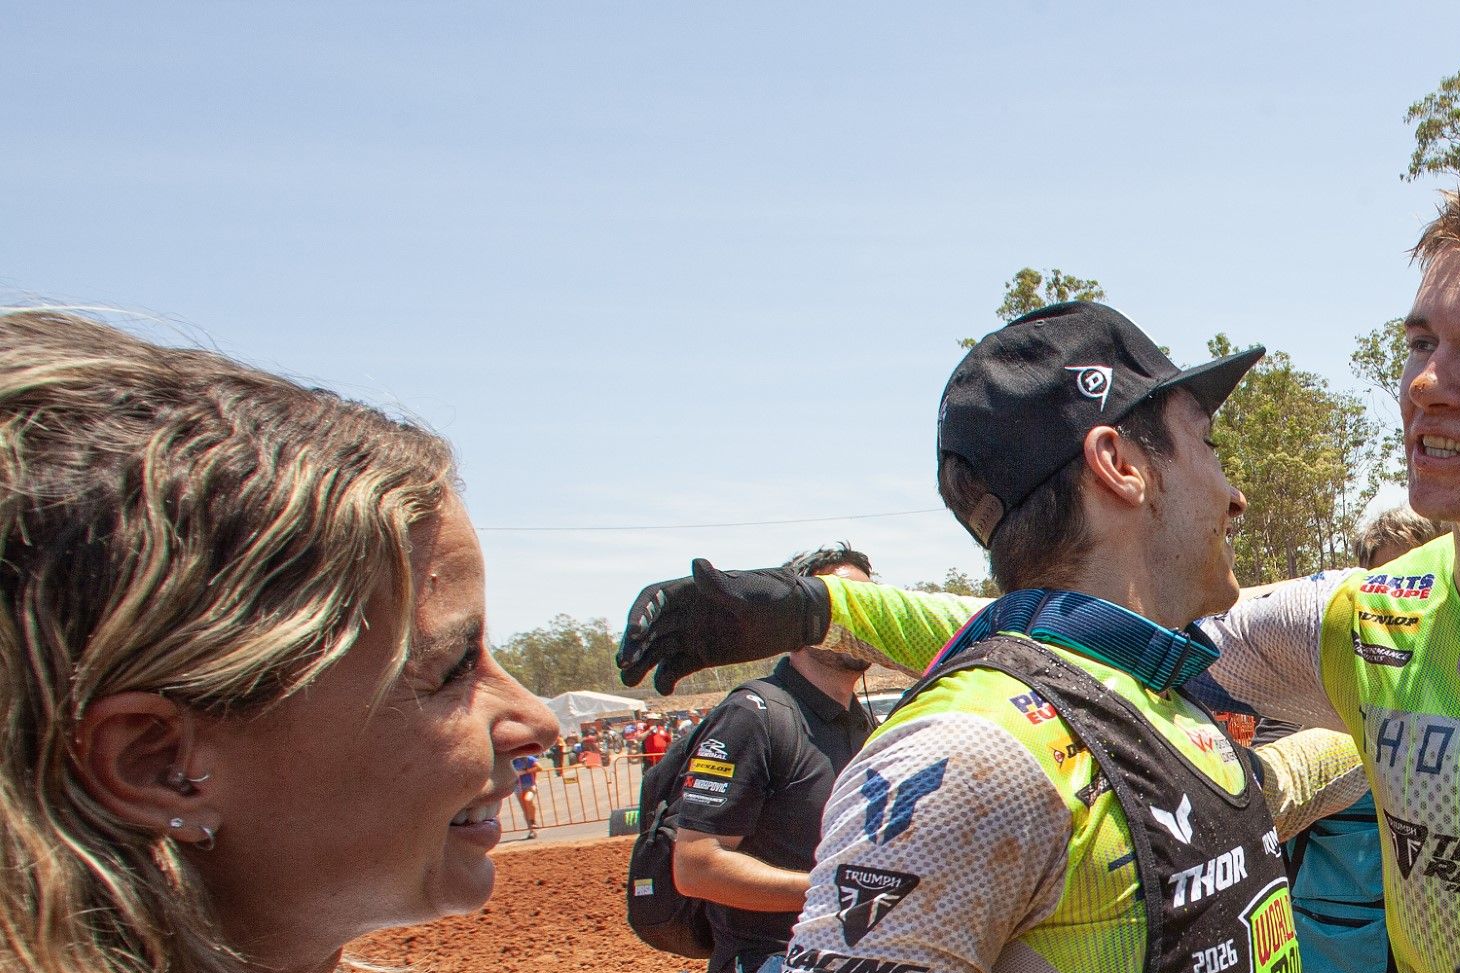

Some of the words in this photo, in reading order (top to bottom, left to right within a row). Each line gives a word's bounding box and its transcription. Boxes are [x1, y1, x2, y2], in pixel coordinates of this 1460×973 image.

[696, 762, 732, 773] DUNLOP
[844, 869, 902, 889] TRIUMPH
[1168, 845, 1249, 908] THOR
